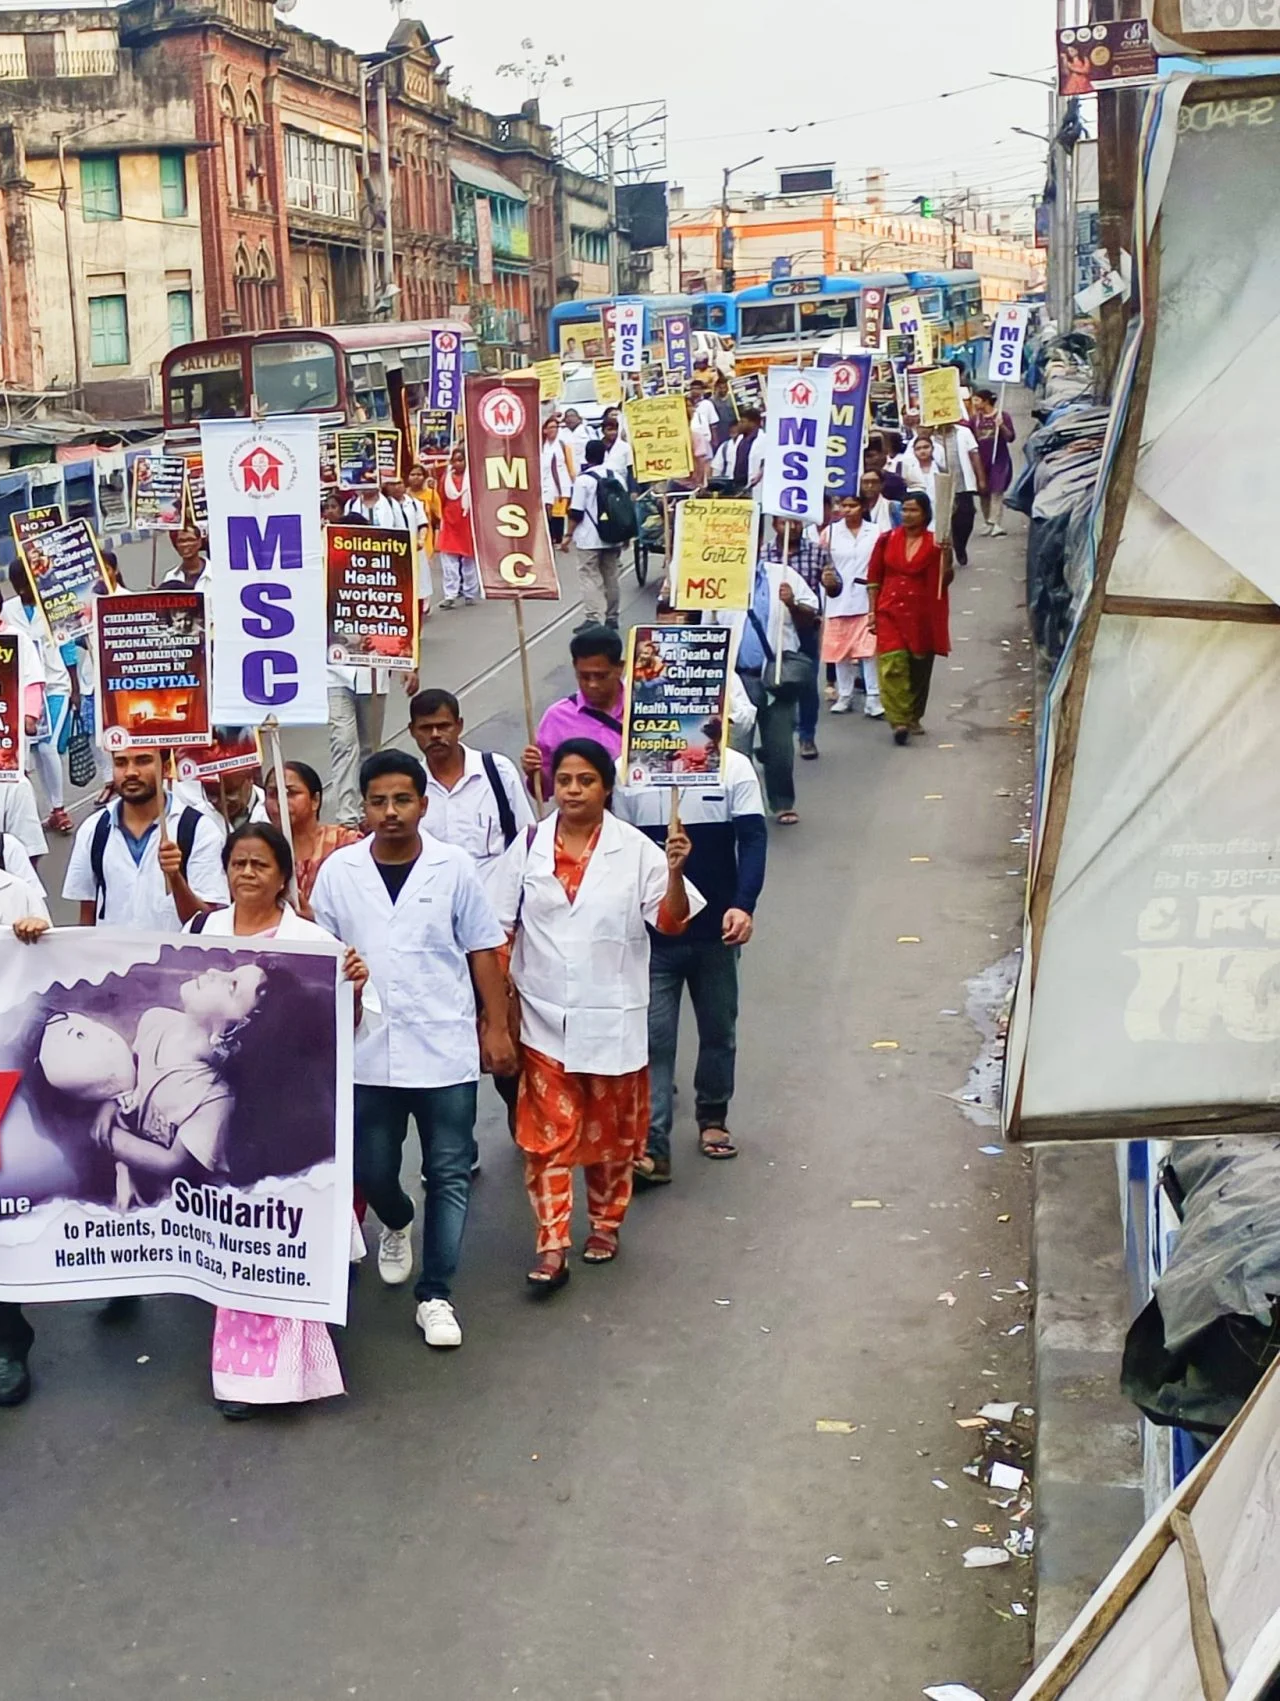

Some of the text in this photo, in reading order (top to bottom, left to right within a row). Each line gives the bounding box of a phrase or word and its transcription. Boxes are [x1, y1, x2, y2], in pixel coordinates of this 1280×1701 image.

[998, 326, 1020, 376] MSC
[436, 352, 455, 408] MSC
[778, 417, 817, 514] MSC
[27, 508, 53, 520] SAY
[484, 457, 538, 587] MSC
[333, 536, 408, 556] Solidarity
[350, 554, 391, 569] to all
[344, 569, 398, 586] Health
[338, 587, 404, 604] workers
[686, 578, 728, 600] MSC
[44, 592, 77, 611] GAZA
[227, 514, 304, 706] MSC
[336, 603, 405, 623] in GAZA,
[333, 619, 409, 637] Palestine
[680, 629, 727, 643] Shocked
[112, 650, 135, 662] AND
[680, 648, 711, 661] Death
[713, 648, 725, 661] of
[667, 666, 724, 680] Children
[107, 674, 200, 692] HOSPITAL
[663, 684, 704, 697] Women
[634, 702, 669, 715] Health
[669, 701, 710, 715] Workers
[632, 719, 681, 732] GAZA
[631, 737, 688, 752] Hospitals
[173, 1180, 304, 1239] Solidarity
[64, 1218, 308, 1261] to Patients, Doctors, Nurses and
[54, 1244, 312, 1287] Health workers in Gaza, Palestine.
